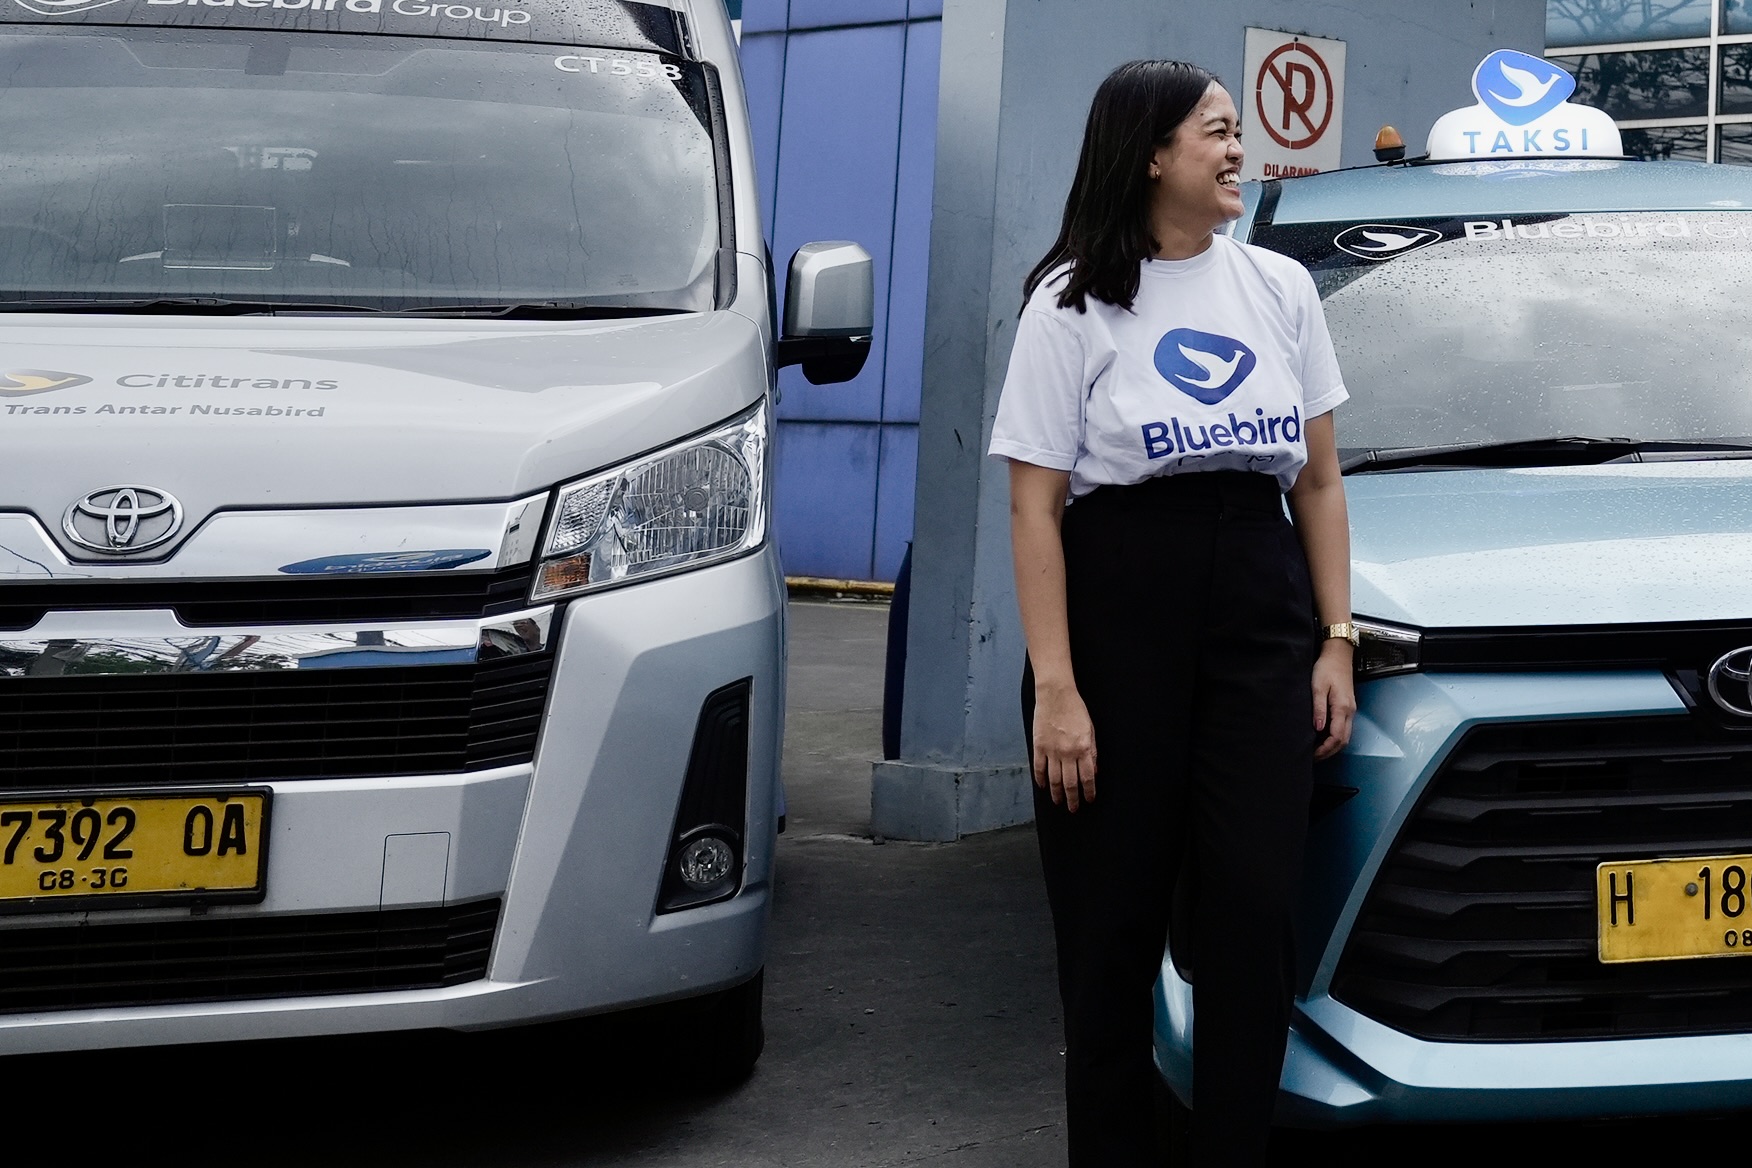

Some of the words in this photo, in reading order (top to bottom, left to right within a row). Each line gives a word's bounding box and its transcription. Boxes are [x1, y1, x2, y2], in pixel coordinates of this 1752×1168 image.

[1463, 128, 1588, 153] TAKSI
[1464, 217, 1691, 241] Bluebird
[116, 374, 339, 390] Cititrans
[4, 404, 87, 415] Trans
[94, 404, 182, 415] Antar
[189, 404, 326, 417] Nusabird
[1141, 405, 1300, 459] Bluebird
[0, 807, 136, 864] 7392
[1608, 870, 1635, 925] H
